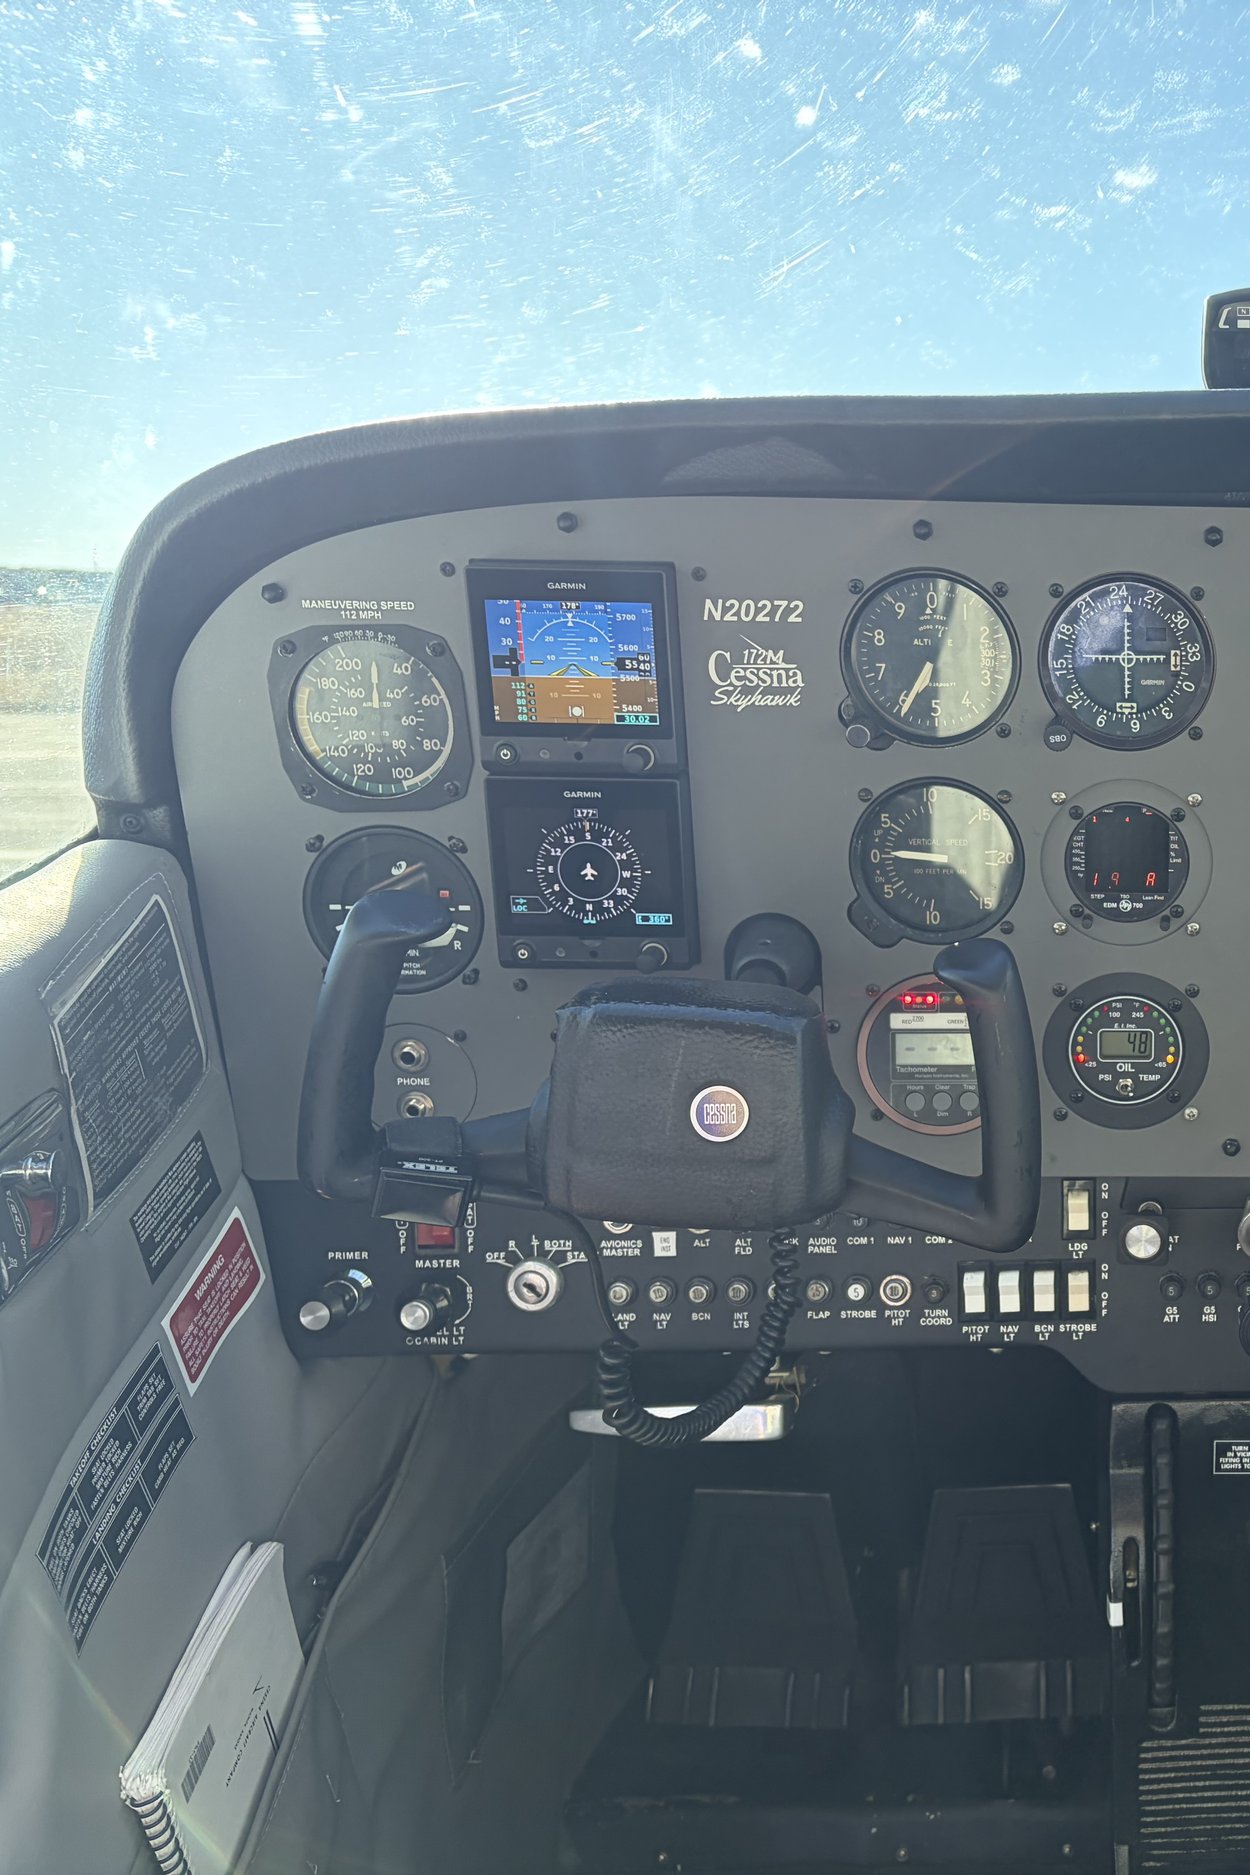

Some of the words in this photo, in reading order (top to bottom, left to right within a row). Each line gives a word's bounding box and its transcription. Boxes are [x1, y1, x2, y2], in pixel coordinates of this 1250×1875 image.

[547, 582, 586, 590] GARMIN
[301, 599, 378, 610] MANEUVERING
[380, 601, 415, 611] SPEED
[703, 598, 804, 623] N20272
[340, 611, 357, 620] 112
[359, 611, 382, 620] MPH
[743, 648, 785, 664] 172M
[335, 658, 362, 671] 200
[708, 650, 805, 687] Cessna
[317, 678, 338, 689] 180
[710, 686, 802, 712] Skyhawk
[392, 767, 414, 779] 100
[1116, 1063, 1135, 1072] OIL
[397, 1077, 430, 1086] PHONE
[703, 1103, 737, 1125] cessna
[544, 1239, 572, 1248] BOTH
[600, 1239, 642, 1248] AVIONICS
[693, 1239, 710, 1247] ALT
[735, 1238, 752, 1246] ALT
[808, 1237, 837, 1245] AUDIO
[847, 1237, 868, 1245] COM
[870, 1237, 875, 1245] 1
[887, 1236, 906, 1244] NAV
[908, 1236, 913, 1244] 1
[735, 1247, 753, 1255] FLD
[808, 1246, 837, 1254] PANEL
[1068, 1243, 1088, 1251] LDG
[328, 1251, 369, 1260] PRIMER
[486, 1252, 506, 1261] OFF
[603, 1248, 640, 1257] MASTER
[1073, 1251, 1084, 1259] LT
[415, 1259, 460, 1268] MASTER
[194, 1253, 227, 1301] WARNING
[840, 1310, 877, 1318] STROBE
[885, 1310, 911, 1318] PITOT
[924, 1309, 949, 1317] TURN
[1203, 1306, 1216, 1314] G5
[734, 1312, 749, 1320] INT
[807, 1311, 830, 1319] FLAP
[1163, 1315, 1179, 1323] ATT
[1202, 1314, 1217, 1322] HSI
[657, 1321, 668, 1329] LT
[733, 1321, 750, 1329] LTS
[891, 1318, 904, 1326] HT
[920, 1318, 953, 1326] COORD
[962, 1325, 990, 1334] PITOT
[1000, 1325, 1019, 1333] NAV
[1034, 1325, 1055, 1333] BCN
[1059, 1324, 1097, 1332] STROBE
[970, 1334, 982, 1342] HT
[1004, 1333, 1015, 1341] LT
[1039, 1333, 1050, 1341] LT
[1073, 1332, 1084, 1340] LT
[68, 1449, 92, 1489] TAKEOFF
[89, 1405, 119, 1452] CHECKLIST
[91, 1502, 118, 1545] LANDING
[115, 1457, 144, 1504] CHECKLIST
